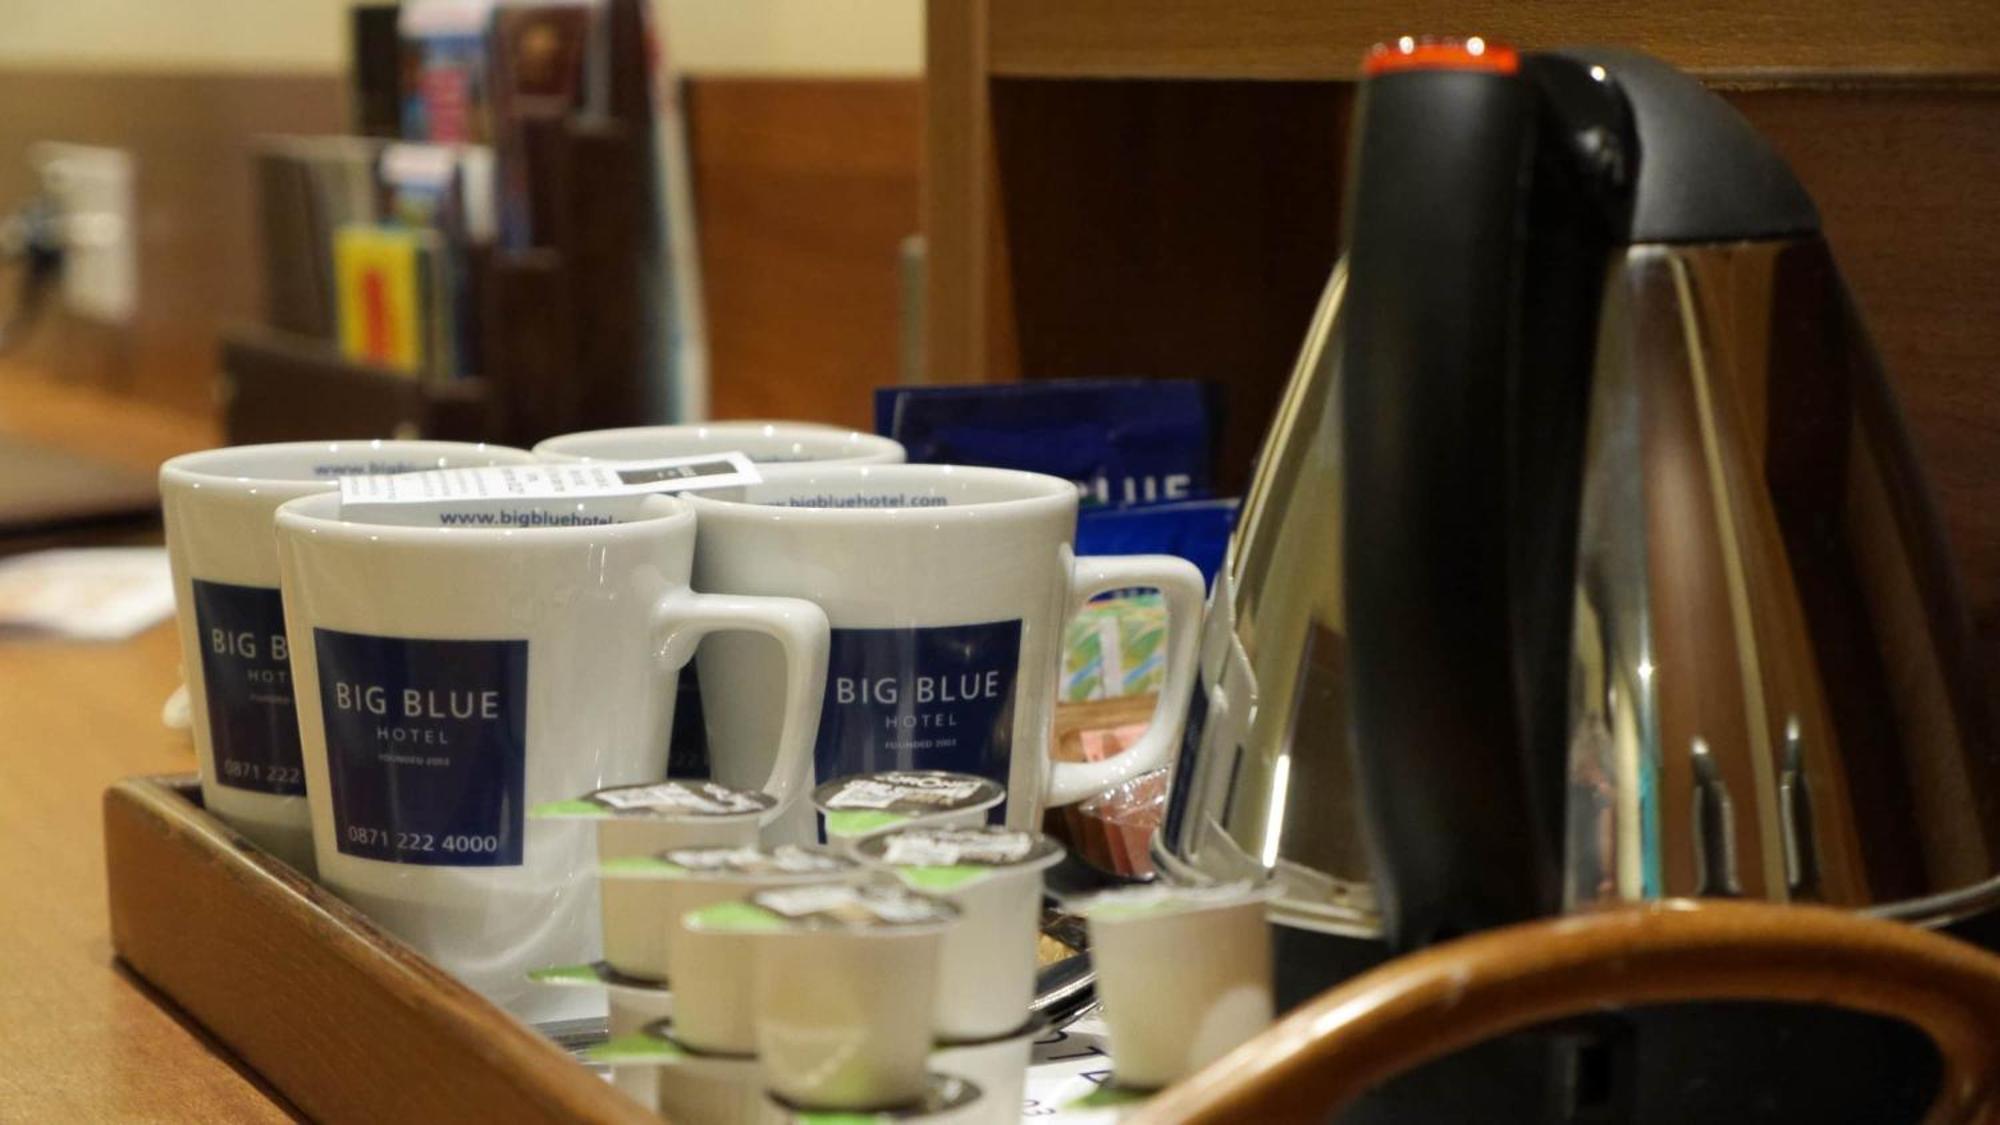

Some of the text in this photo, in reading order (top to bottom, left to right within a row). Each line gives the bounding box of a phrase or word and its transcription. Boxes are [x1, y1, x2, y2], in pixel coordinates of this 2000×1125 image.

[1079, 474, 1191, 503] LUE
[211, 628, 288, 661] BIG B
[247, 669, 287, 684] HOT
[836, 671, 999, 704] BIG BLUE
[336, 682, 499, 719] BIG BLUE
[885, 713, 957, 729] HOTEL
[376, 726, 448, 745] HOTEL
[224, 759, 300, 784] 0871 222
[348, 825, 497, 852] 0871 222 4000
